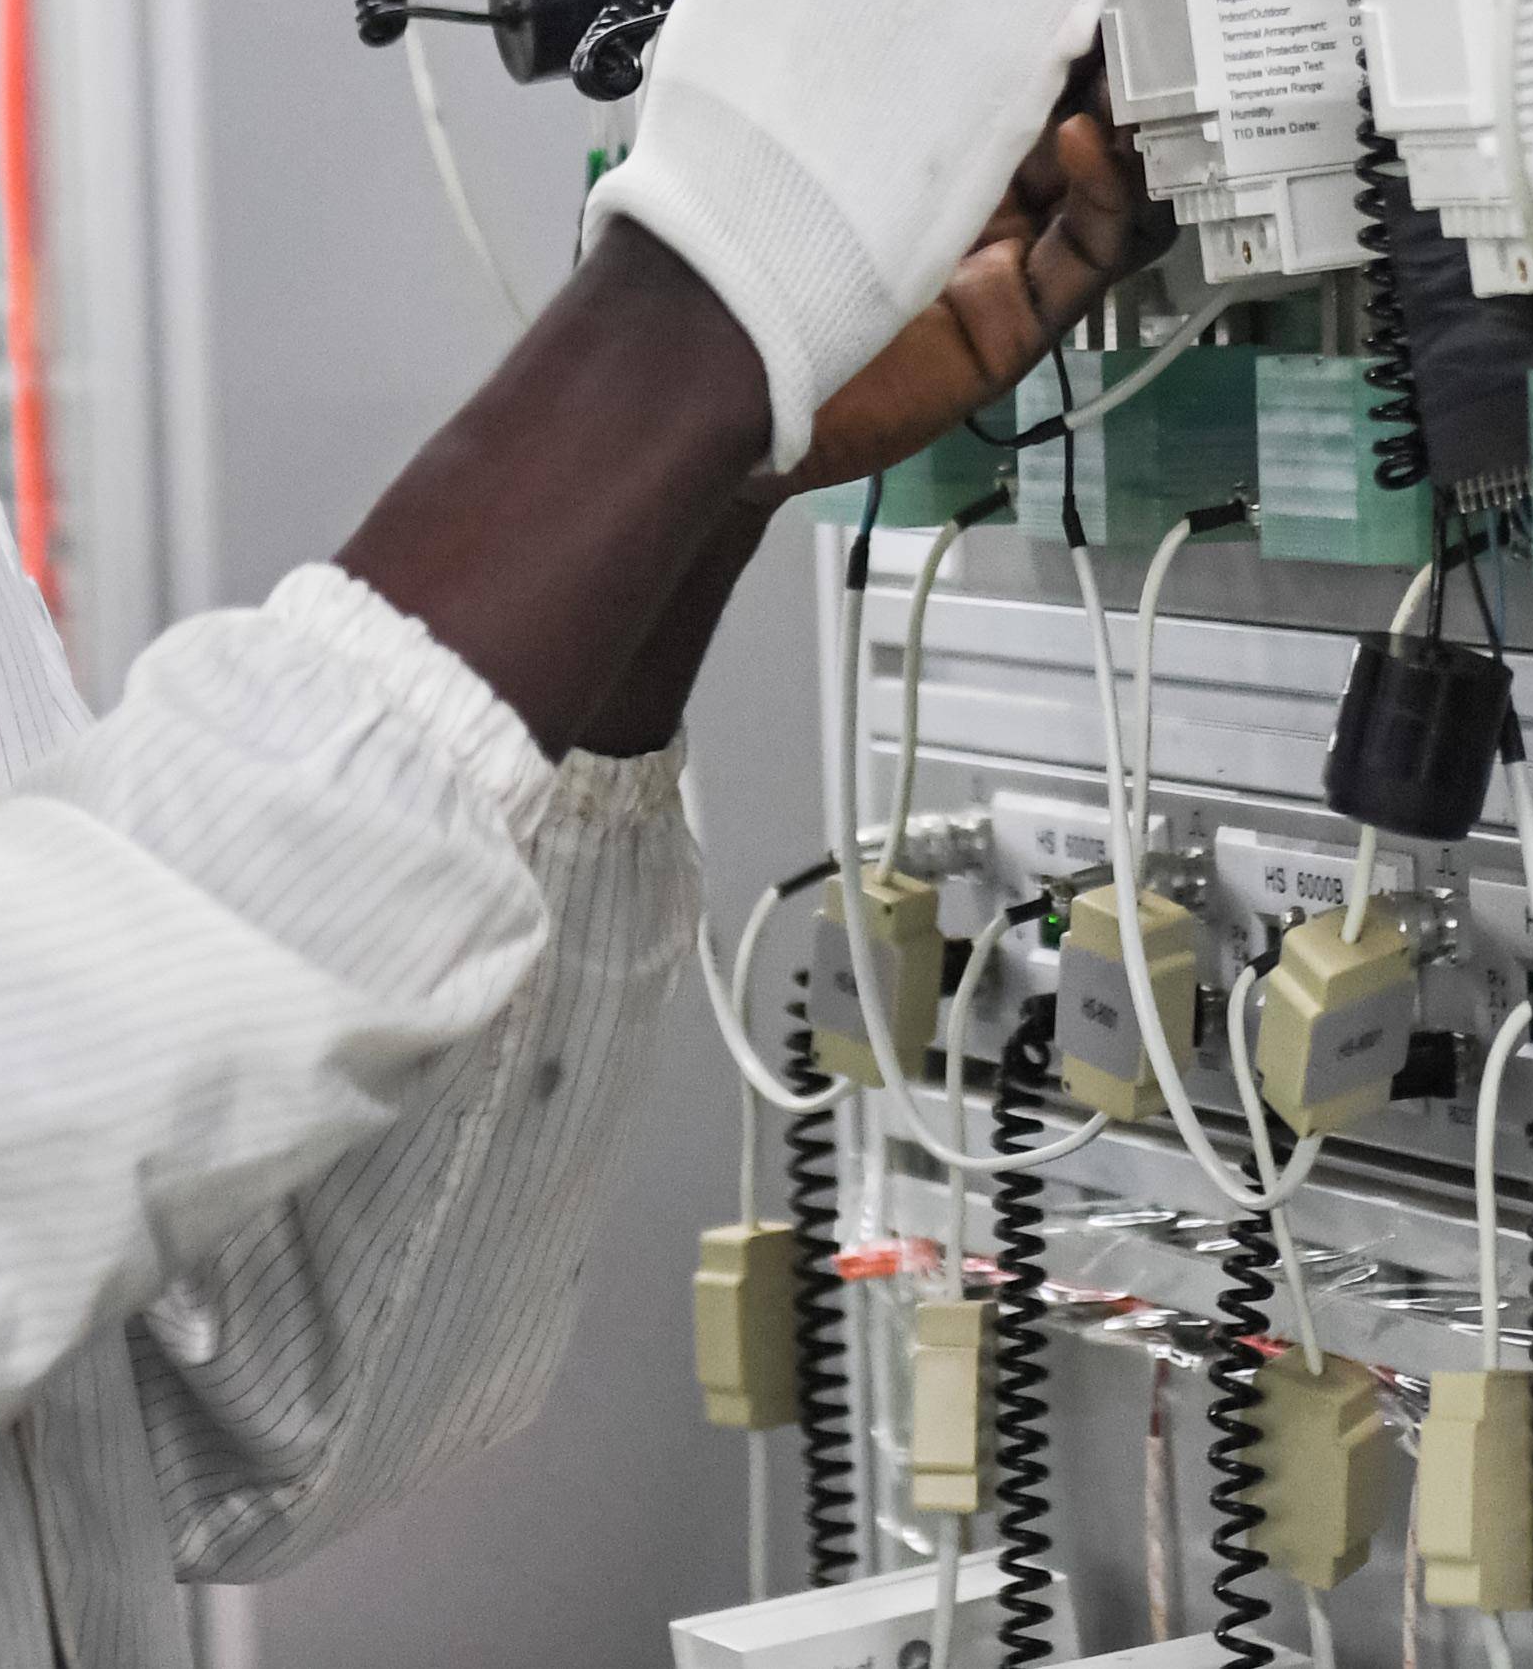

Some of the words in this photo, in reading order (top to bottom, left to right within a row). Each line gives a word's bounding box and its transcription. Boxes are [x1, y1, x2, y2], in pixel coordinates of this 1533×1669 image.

[1222, 29, 1262, 43] Terminal
[1223, 49, 1265, 63] Insulation
[1266, 43, 1309, 57] Protection
[1226, 68, 1263, 82] Impulse
[1265, 63, 1302, 77] Voltage
[1229, 85, 1289, 101] Temperature
[1256, 124, 1286, 138] Base
[1288, 120, 1322, 135] Date:
[1266, 865, 1286, 894] HS
[1297, 871, 1344, 905] 6000B
